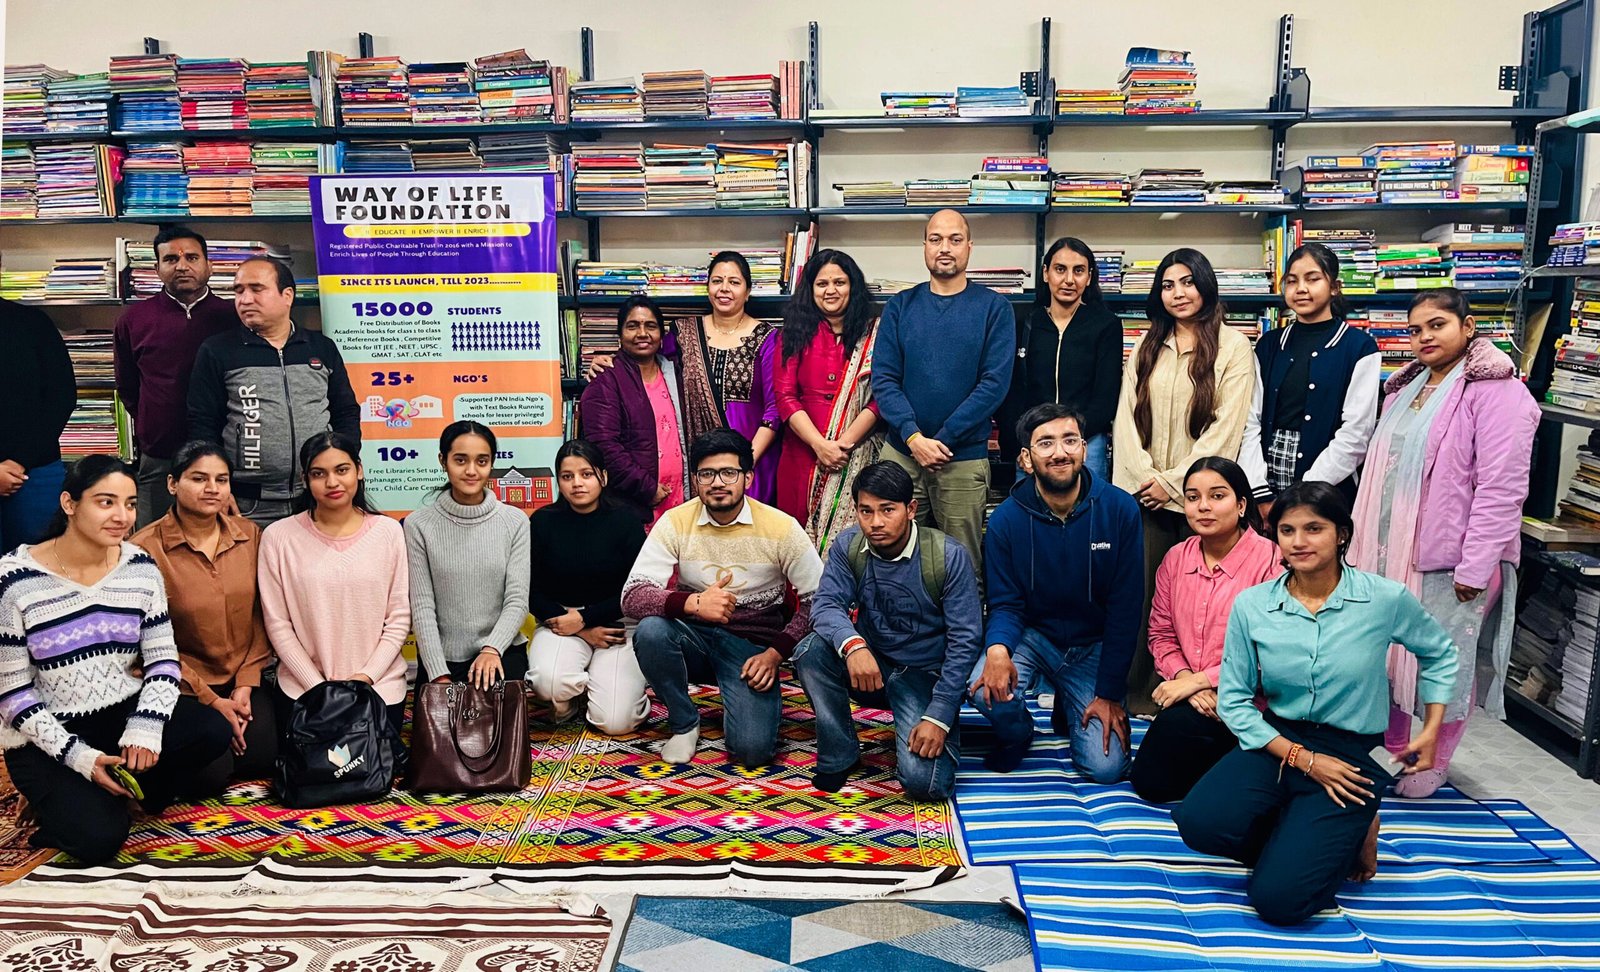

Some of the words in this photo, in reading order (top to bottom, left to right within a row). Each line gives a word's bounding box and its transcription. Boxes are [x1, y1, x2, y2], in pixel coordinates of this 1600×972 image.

[334, 187, 397, 202] WAY
[408, 186, 438, 202] OF
[449, 186, 502, 201] LIFE
[336, 204, 510, 220] FOUNDATION
[352, 302, 433, 316] 15000
[447, 307, 502, 315] STUDENTS
[371, 372, 414, 386] 25+
[453, 375, 488, 383] NGO'S
[238, 384, 261, 470] HILFIGER
[386, 420, 411, 428] NGO
[378, 447, 419, 461] 10+
[334, 755, 365, 779] SPUNKY
